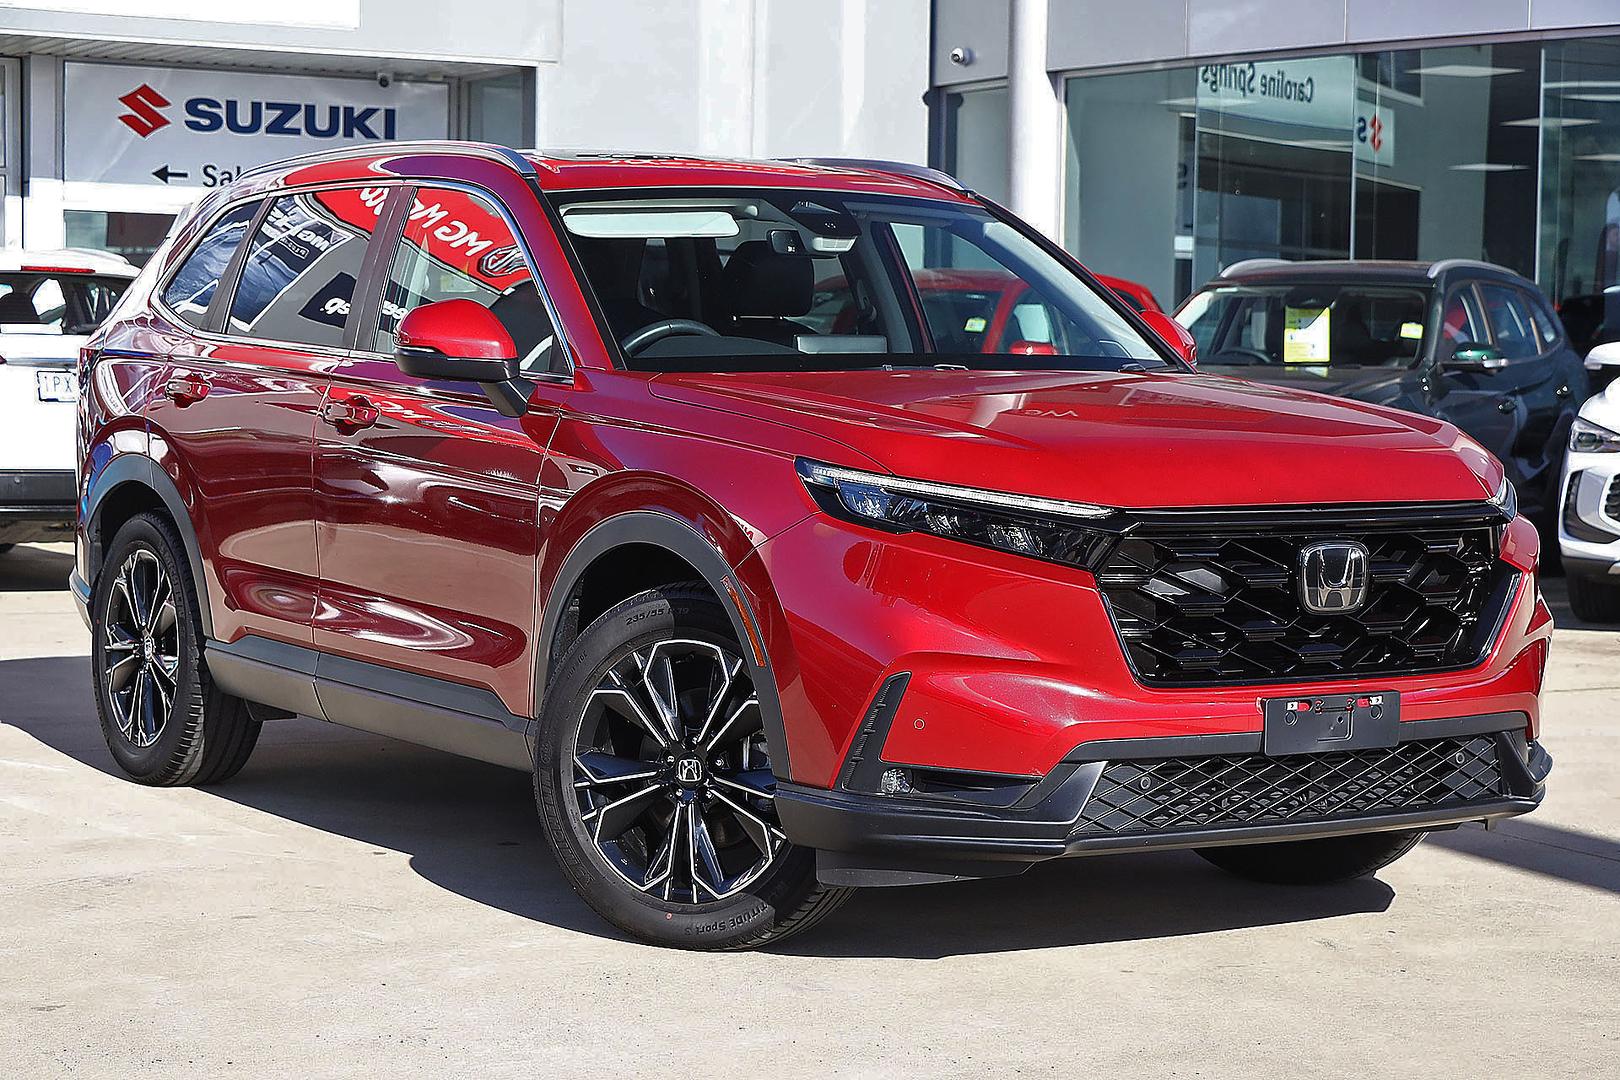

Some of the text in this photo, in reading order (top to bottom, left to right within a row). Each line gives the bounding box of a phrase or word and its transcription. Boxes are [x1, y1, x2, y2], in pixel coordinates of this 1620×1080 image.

[184, 97, 397, 140] SUZUKI
[625, 608, 665, 626] 235/55
[729, 903, 769, 928] TITUDE
